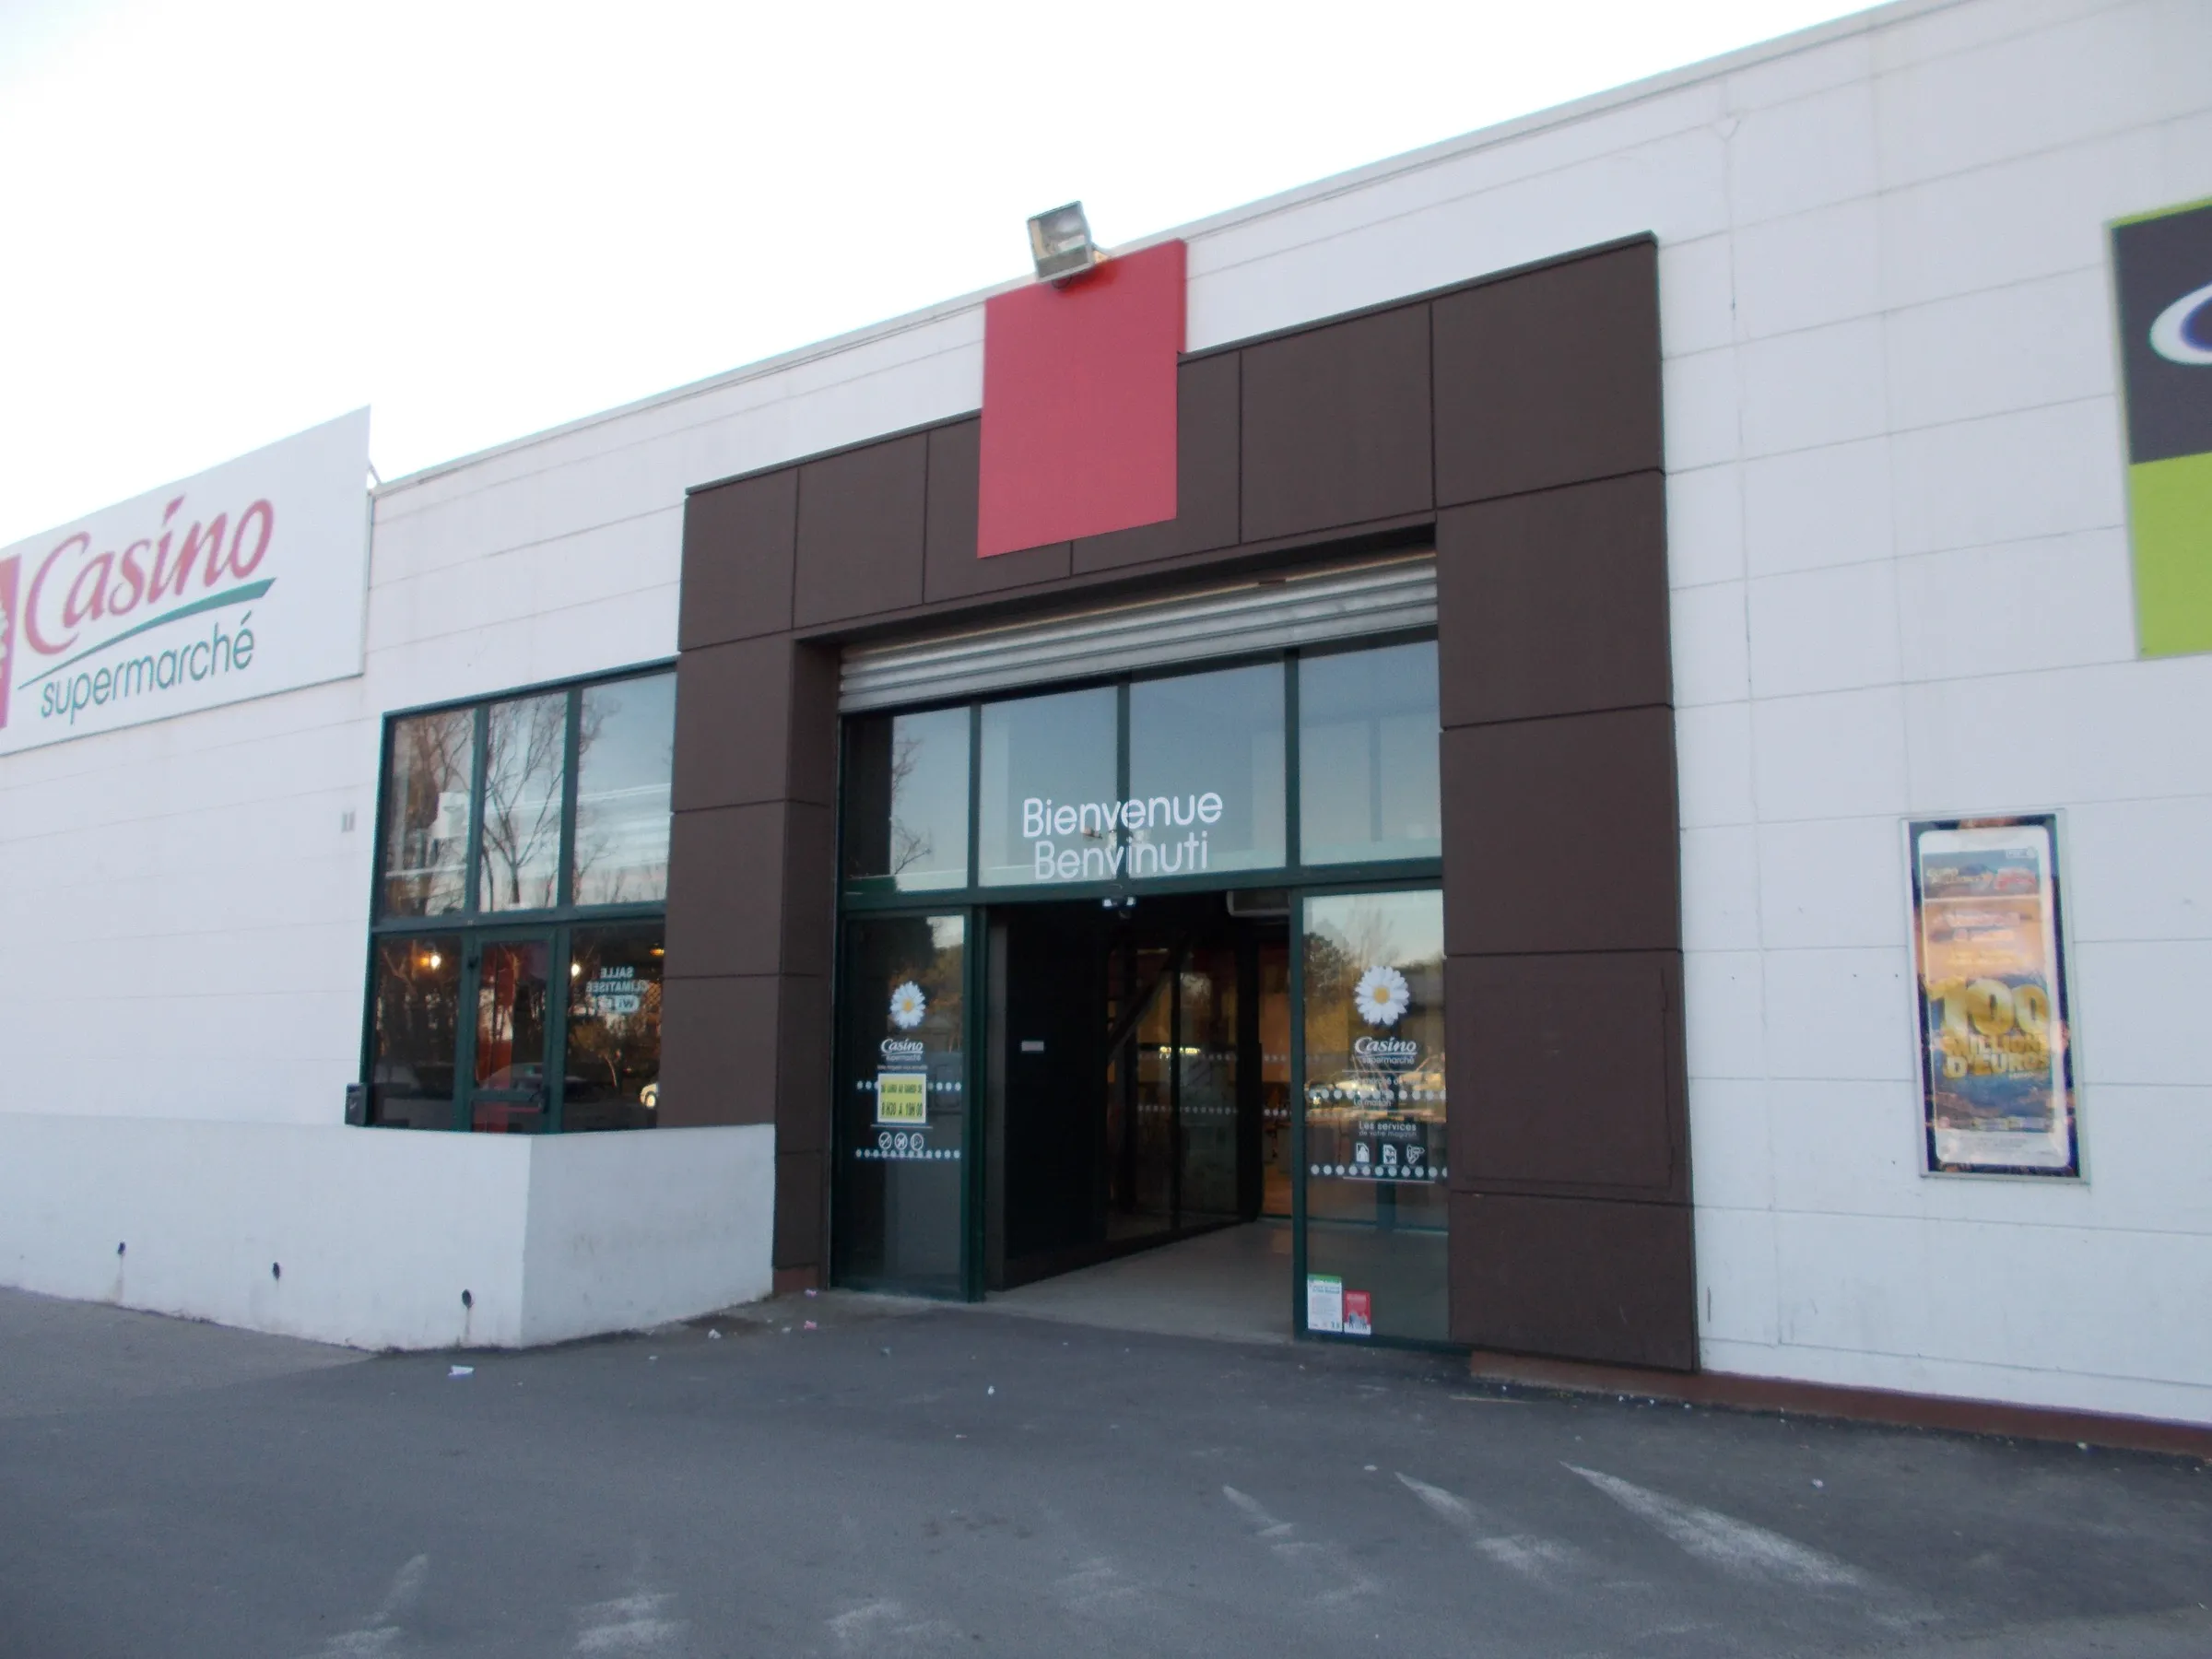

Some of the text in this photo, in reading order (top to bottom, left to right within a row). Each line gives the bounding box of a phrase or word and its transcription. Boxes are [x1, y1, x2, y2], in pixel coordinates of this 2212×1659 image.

[24, 495, 275, 656] Casino
[41, 609, 255, 725] supermarché
[1022, 792, 1223, 838] Bienvenue
[1034, 830, 1208, 880] Benvinuti
[1928, 977, 2050, 1036] 100
[880, 1037, 924, 1053] Casino
[1354, 1036, 1417, 1054] Casino
[1359, 1120, 1417, 1131] Les services
